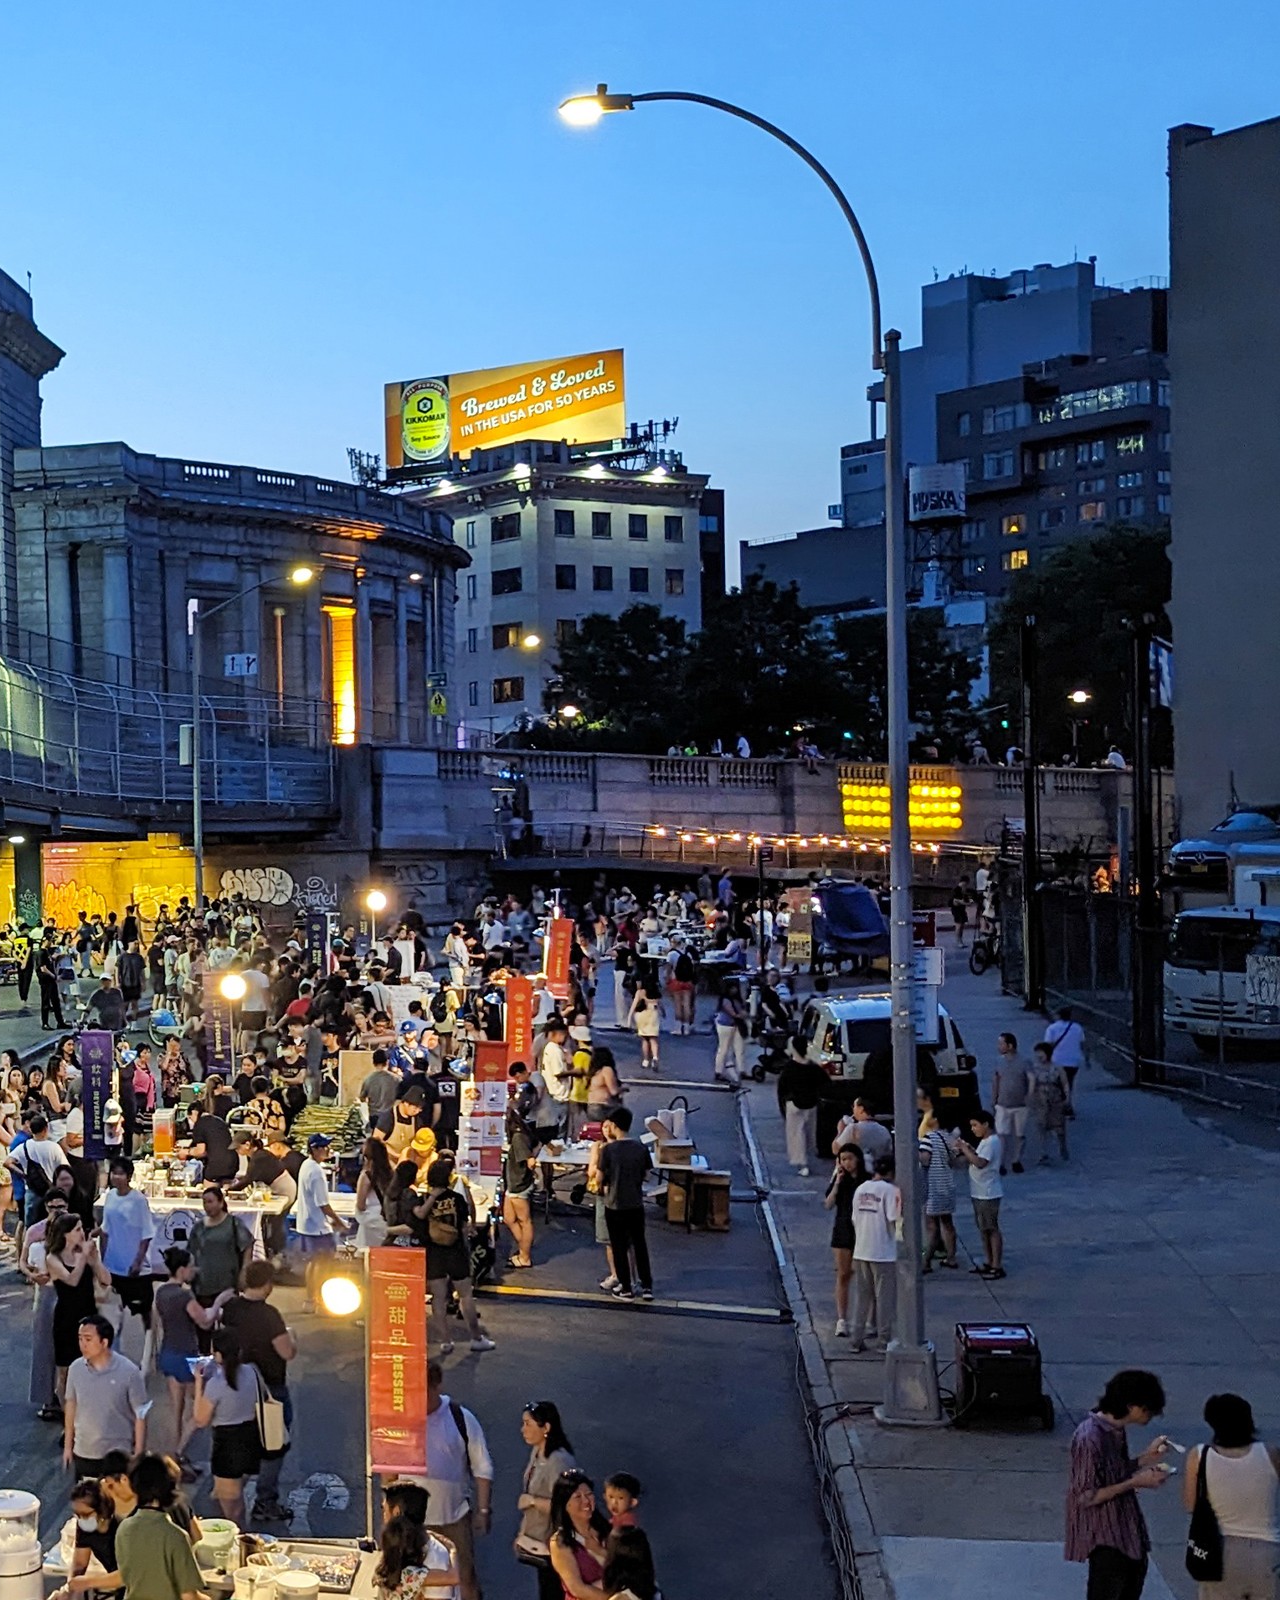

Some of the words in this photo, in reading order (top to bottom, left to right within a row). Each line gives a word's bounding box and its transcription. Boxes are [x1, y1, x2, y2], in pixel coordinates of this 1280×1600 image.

[460, 384, 528, 418] Brewed
[531, 376, 547, 397] &
[549, 359, 606, 391] Loved
[405, 413, 446, 425] KIKKOMAN
[460, 425, 474, 438] IN
[475, 416, 500, 433] THE
[500, 408, 527, 425] USA
[527, 400, 554, 417] FOR
[555, 394, 574, 408] 50
[574, 380, 617, 402] YEARS
[410, 435, 422, 443] Soy
[515, 1028, 524, 1052] EATS
[93, 1091, 101, 1130] BEVERAGE
[388, 1306, 407, 1345] 甜品
[393, 1354, 404, 1412] DESSERT
